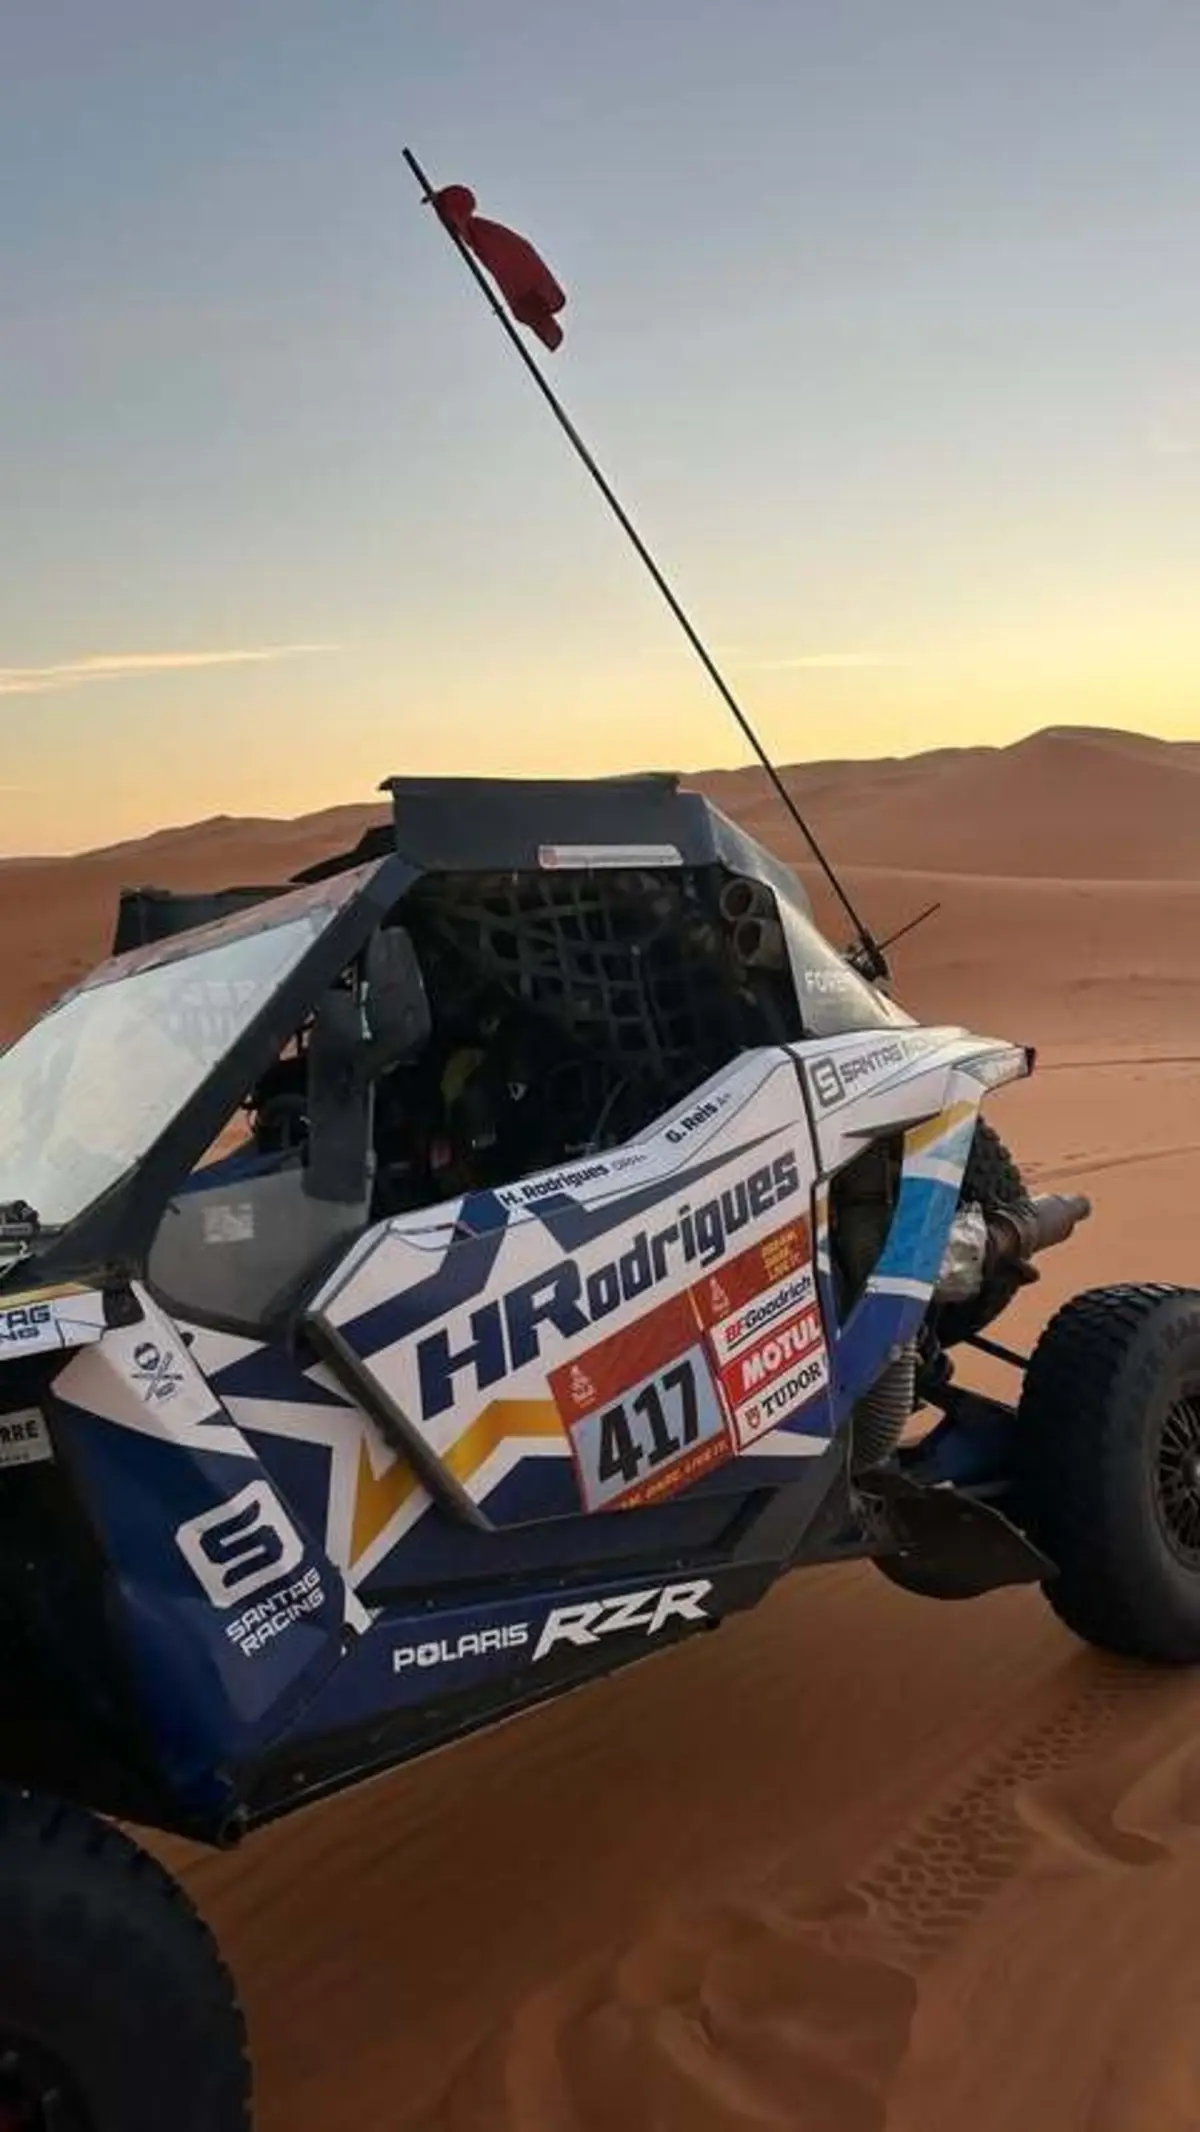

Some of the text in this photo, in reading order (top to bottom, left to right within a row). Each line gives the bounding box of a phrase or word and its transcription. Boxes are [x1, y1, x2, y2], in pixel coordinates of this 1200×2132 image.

[681, 1102, 719, 1131] Reis
[499, 1191, 524, 1207] H.
[522, 1164, 610, 1200] Rodrigues
[724, 1276, 812, 1342] BFGoodrich
[742, 1315, 822, 1391] MOTUL
[598, 1359, 700, 1484] 417
[761, 1361, 823, 1418] TUDOR
[224, 1567, 321, 1643] SANTAG
[239, 1586, 325, 1657] RACING
[393, 1578, 714, 1674] POLARIS RZR
